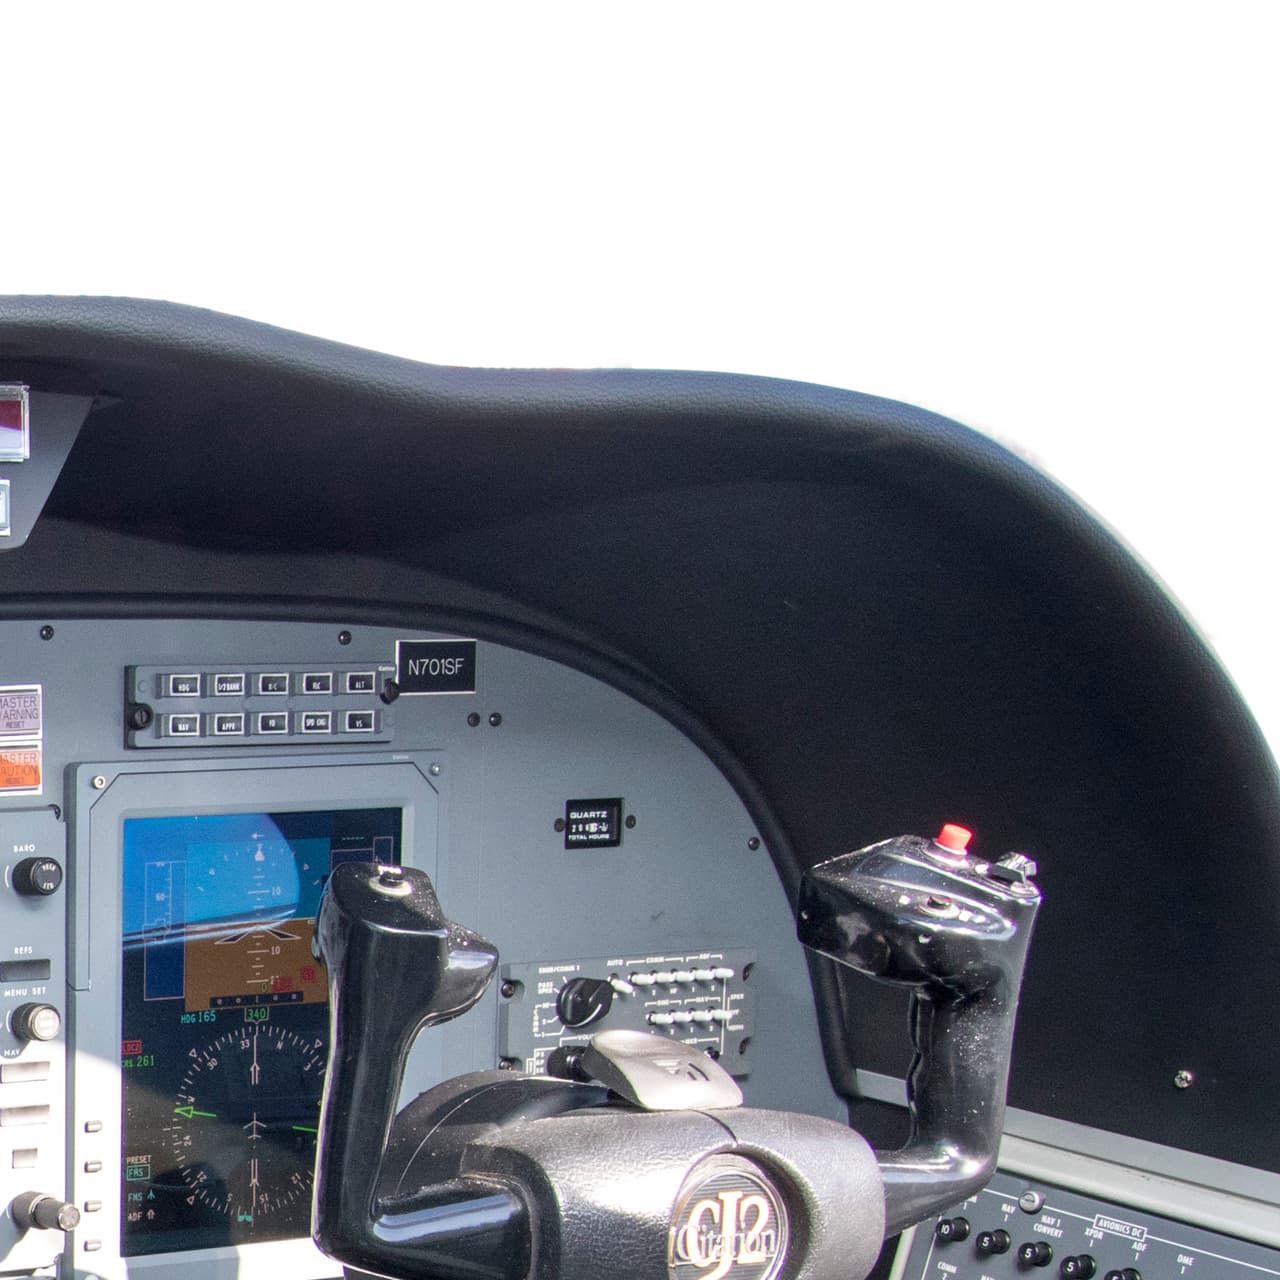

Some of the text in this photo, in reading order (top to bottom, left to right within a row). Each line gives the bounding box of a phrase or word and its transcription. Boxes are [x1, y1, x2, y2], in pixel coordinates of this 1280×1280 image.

[408, 658, 464, 677] N701SF
[569, 811, 607, 819] QUARTZ
[1098, 1218, 1143, 1238] AVIONICS DC
